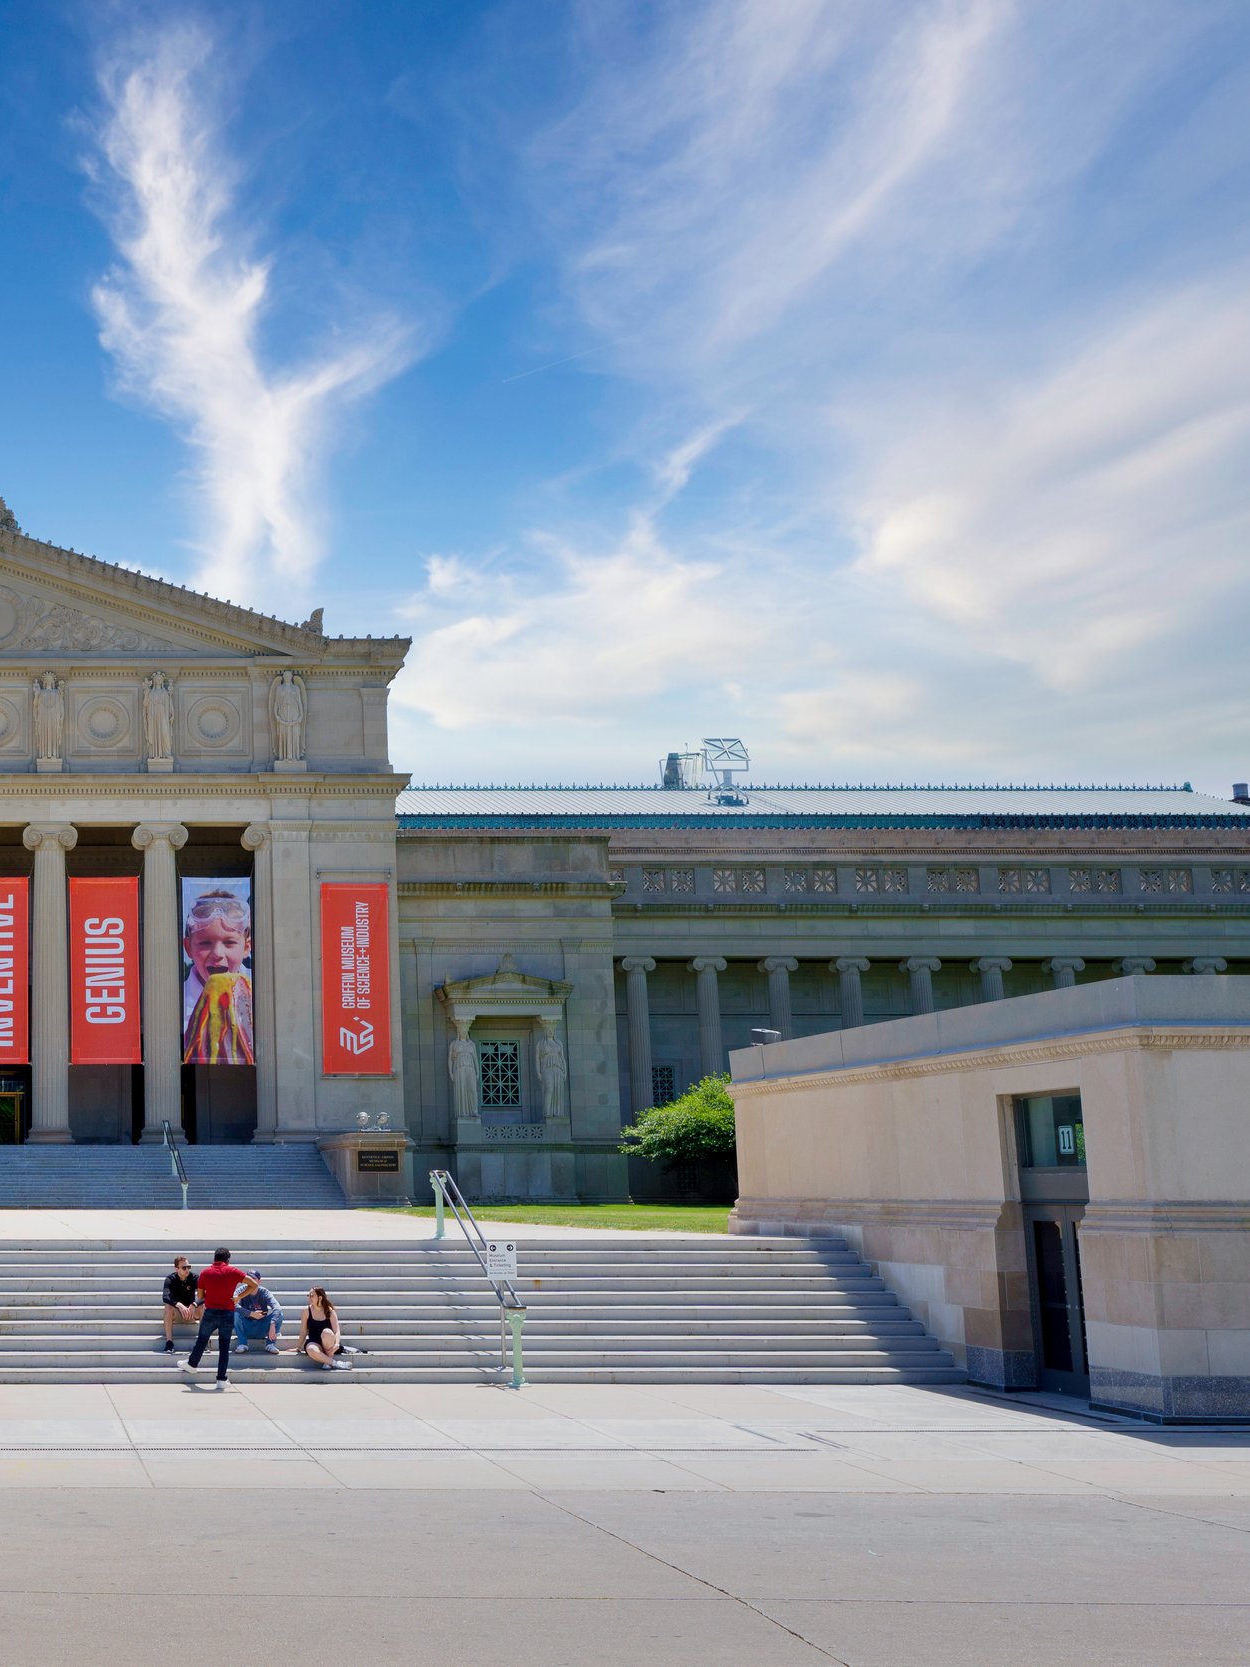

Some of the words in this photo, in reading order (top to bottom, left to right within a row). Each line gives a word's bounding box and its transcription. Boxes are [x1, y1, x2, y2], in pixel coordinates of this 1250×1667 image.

[340, 926, 354, 970] MUSEUM
[84, 917, 126, 1024] GENIUS
[341, 973, 355, 1009] GRIFFIN
[357, 997, 371, 1009] OF
[1061, 1130, 1072, 1150] 11
